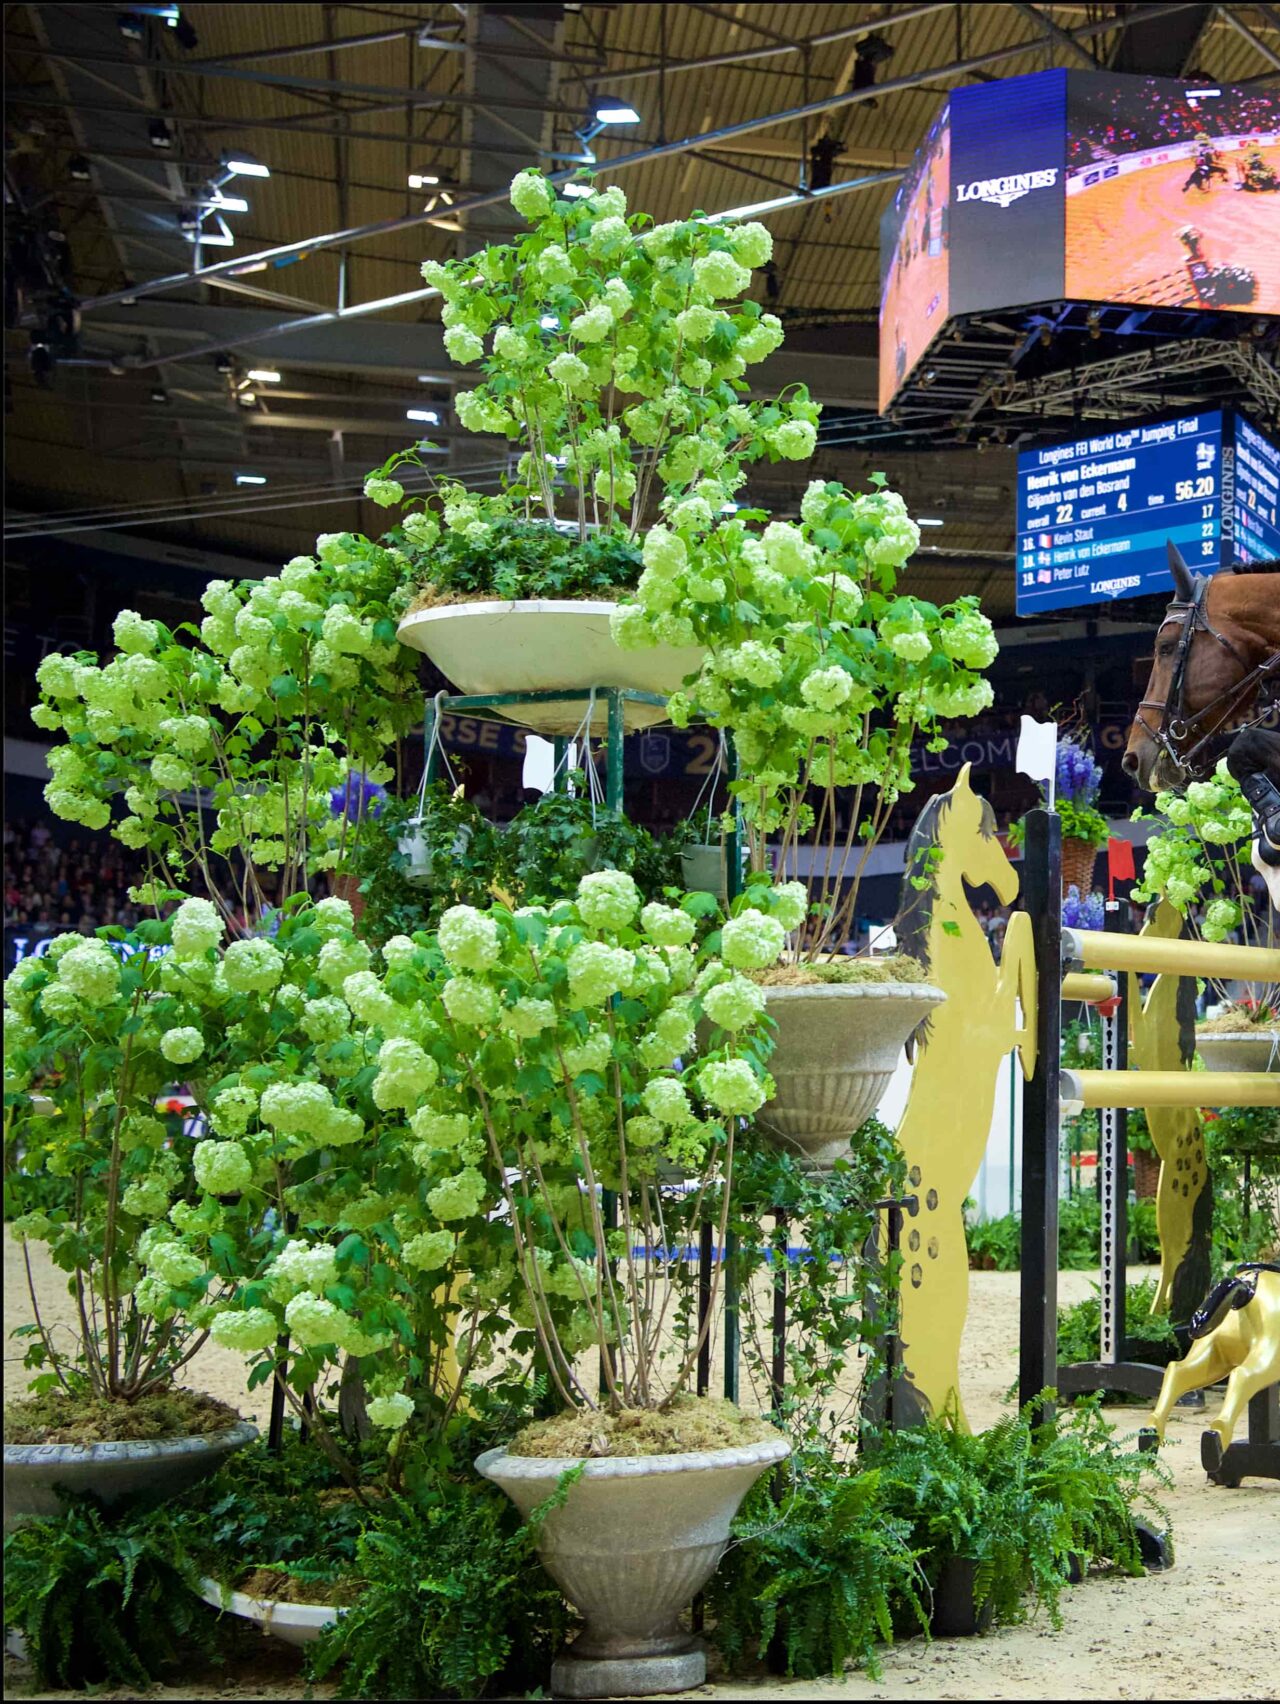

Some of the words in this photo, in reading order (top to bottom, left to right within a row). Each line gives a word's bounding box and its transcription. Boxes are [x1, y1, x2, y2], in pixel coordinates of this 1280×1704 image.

[956, 168, 1059, 202] LONGINES
[1039, 446, 1075, 465] Longines
[1090, 436, 1114, 453] World
[1141, 423, 1176, 443] Jumping
[1177, 417, 1199, 435] Final
[1027, 470, 1060, 491] Henrik
[1060, 469, 1079, 484] von
[1080, 457, 1136, 480] Eckermann
[1079, 484, 1096, 498] den
[1221, 447, 1235, 542] LONGINES
[1056, 503, 1074, 524] 22
[1080, 503, 1107, 519] current
[1117, 492, 1128, 511] 4
[1147, 494, 1165, 506] time
[1174, 475, 1215, 501] 56.20
[1053, 531, 1074, 546] Kevin
[1074, 526, 1095, 543] Staut
[1201, 503, 1214, 519] 17
[1053, 547, 1077, 564] Henrik
[1091, 540, 1131, 557] Eckermann
[1201, 522, 1214, 538] 22
[1053, 567, 1073, 582] Peter
[1201, 540, 1214, 556] 32
[1090, 575, 1141, 594] LONGINES
